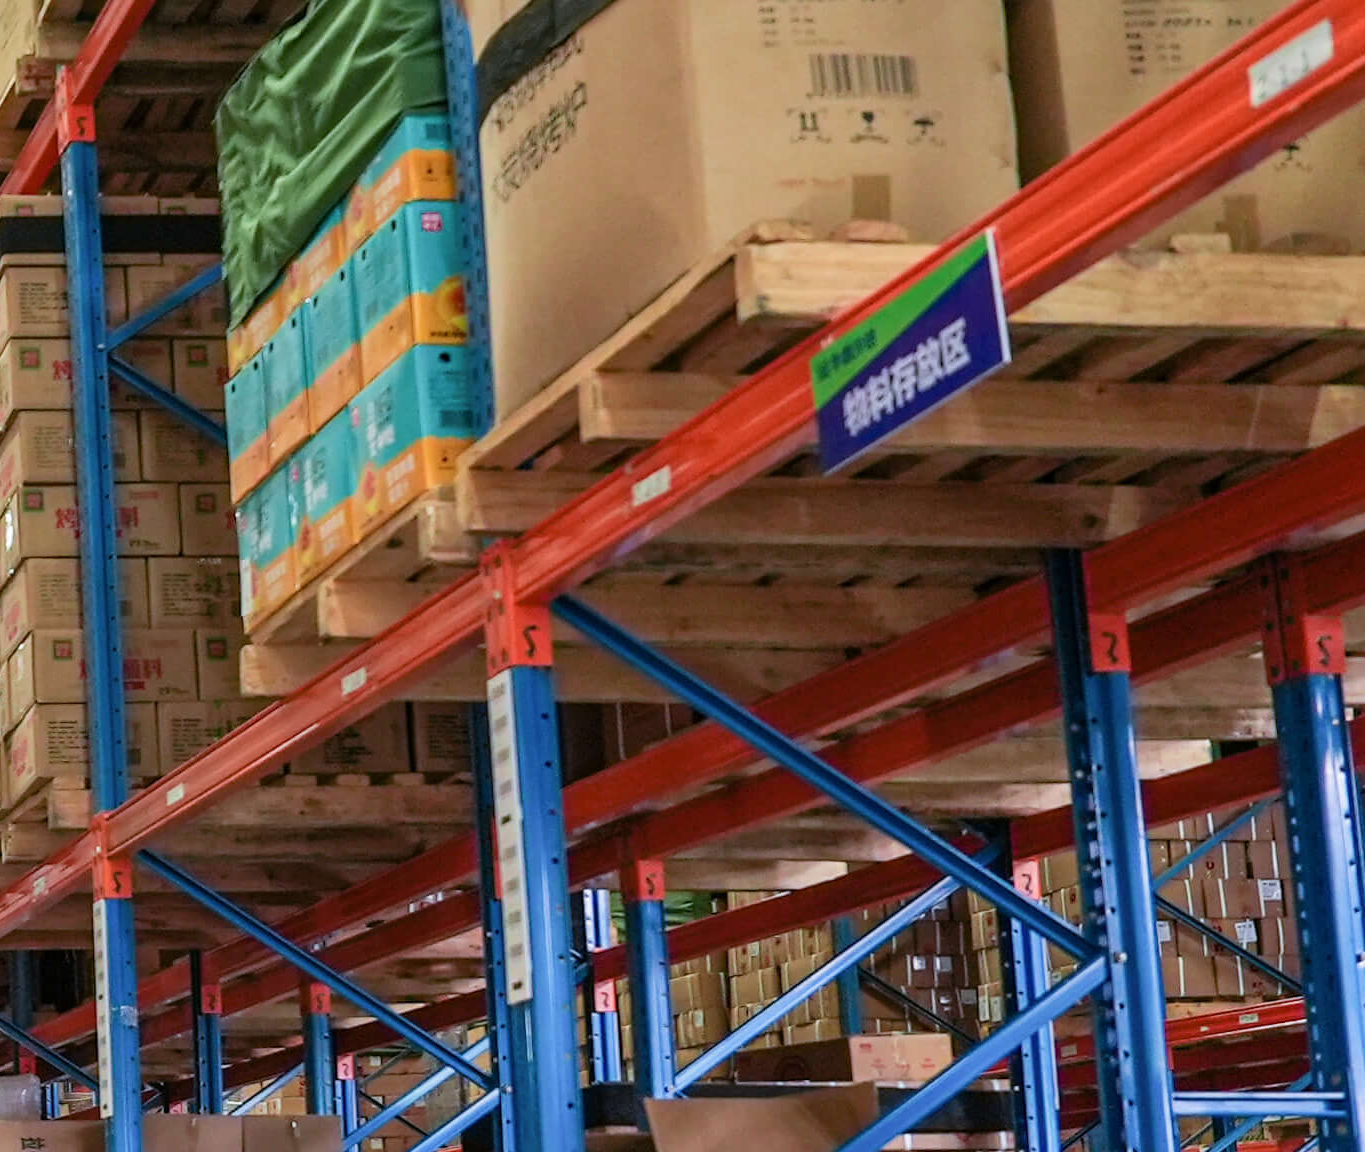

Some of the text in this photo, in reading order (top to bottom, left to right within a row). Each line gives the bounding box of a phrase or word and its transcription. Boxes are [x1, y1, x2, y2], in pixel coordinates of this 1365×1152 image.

[842, 317, 972, 437] 物料存放区
